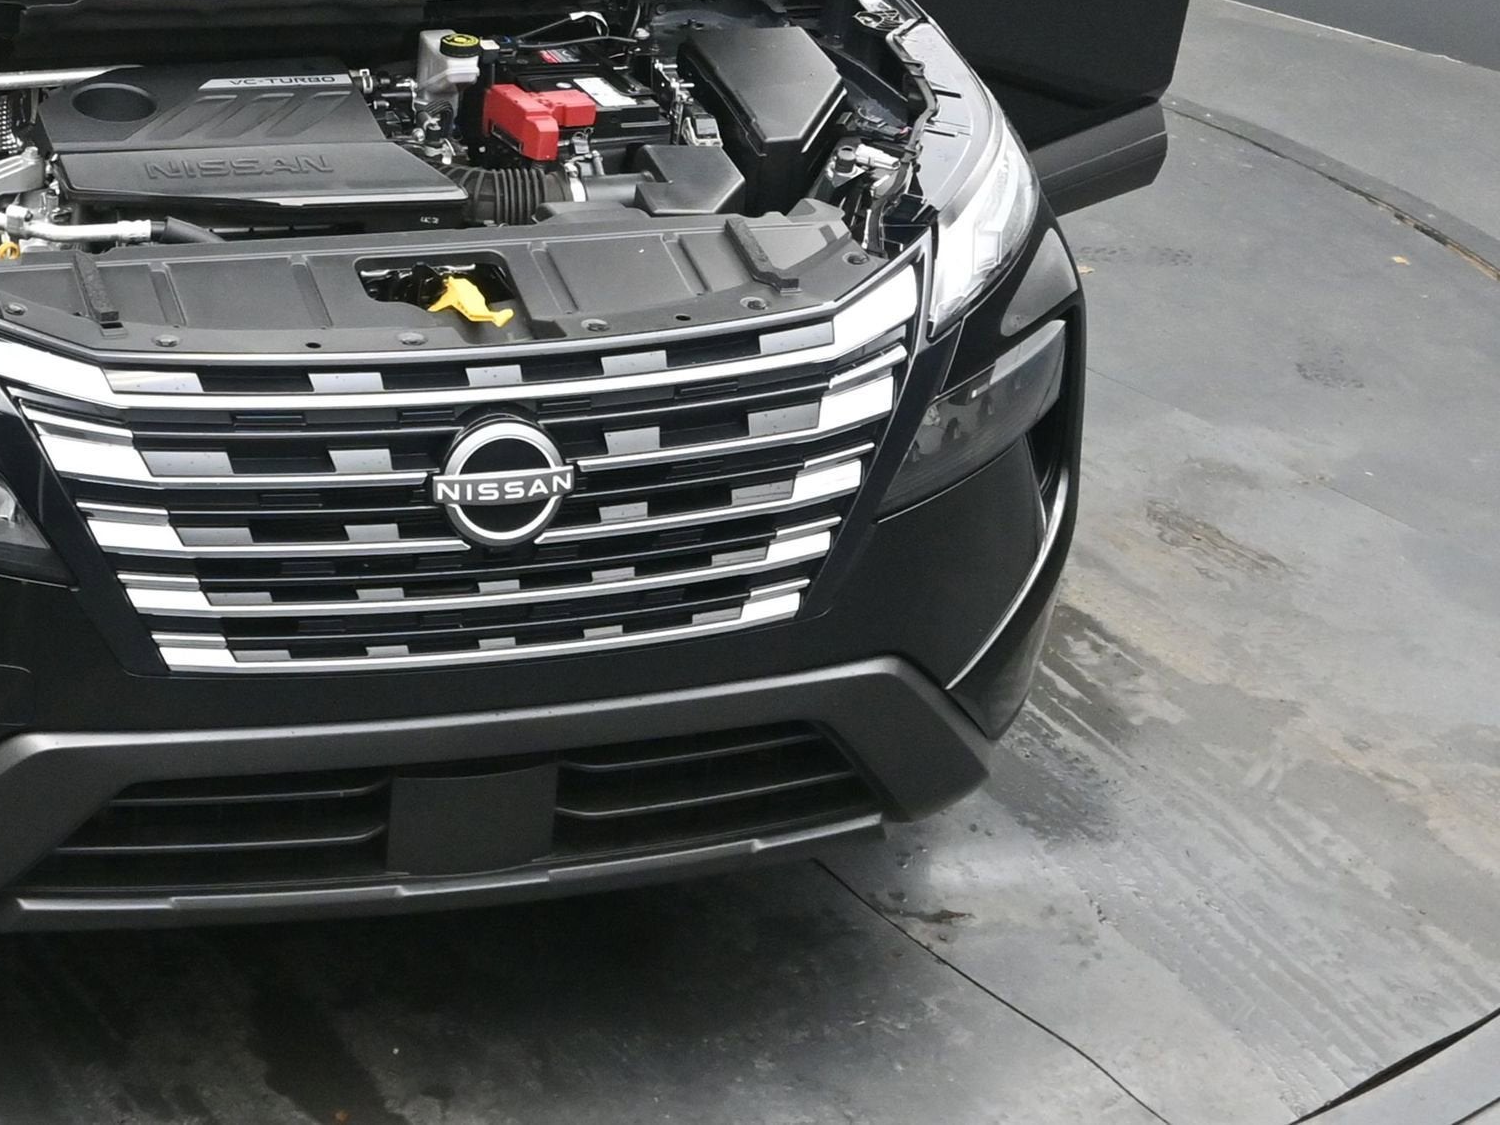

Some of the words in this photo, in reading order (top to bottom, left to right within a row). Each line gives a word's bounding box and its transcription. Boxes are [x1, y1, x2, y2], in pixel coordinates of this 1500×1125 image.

[229, 76, 336, 86] VC-TURBO
[146, 155, 334, 180] NISSAN
[437, 473, 572, 501] NISSAN
